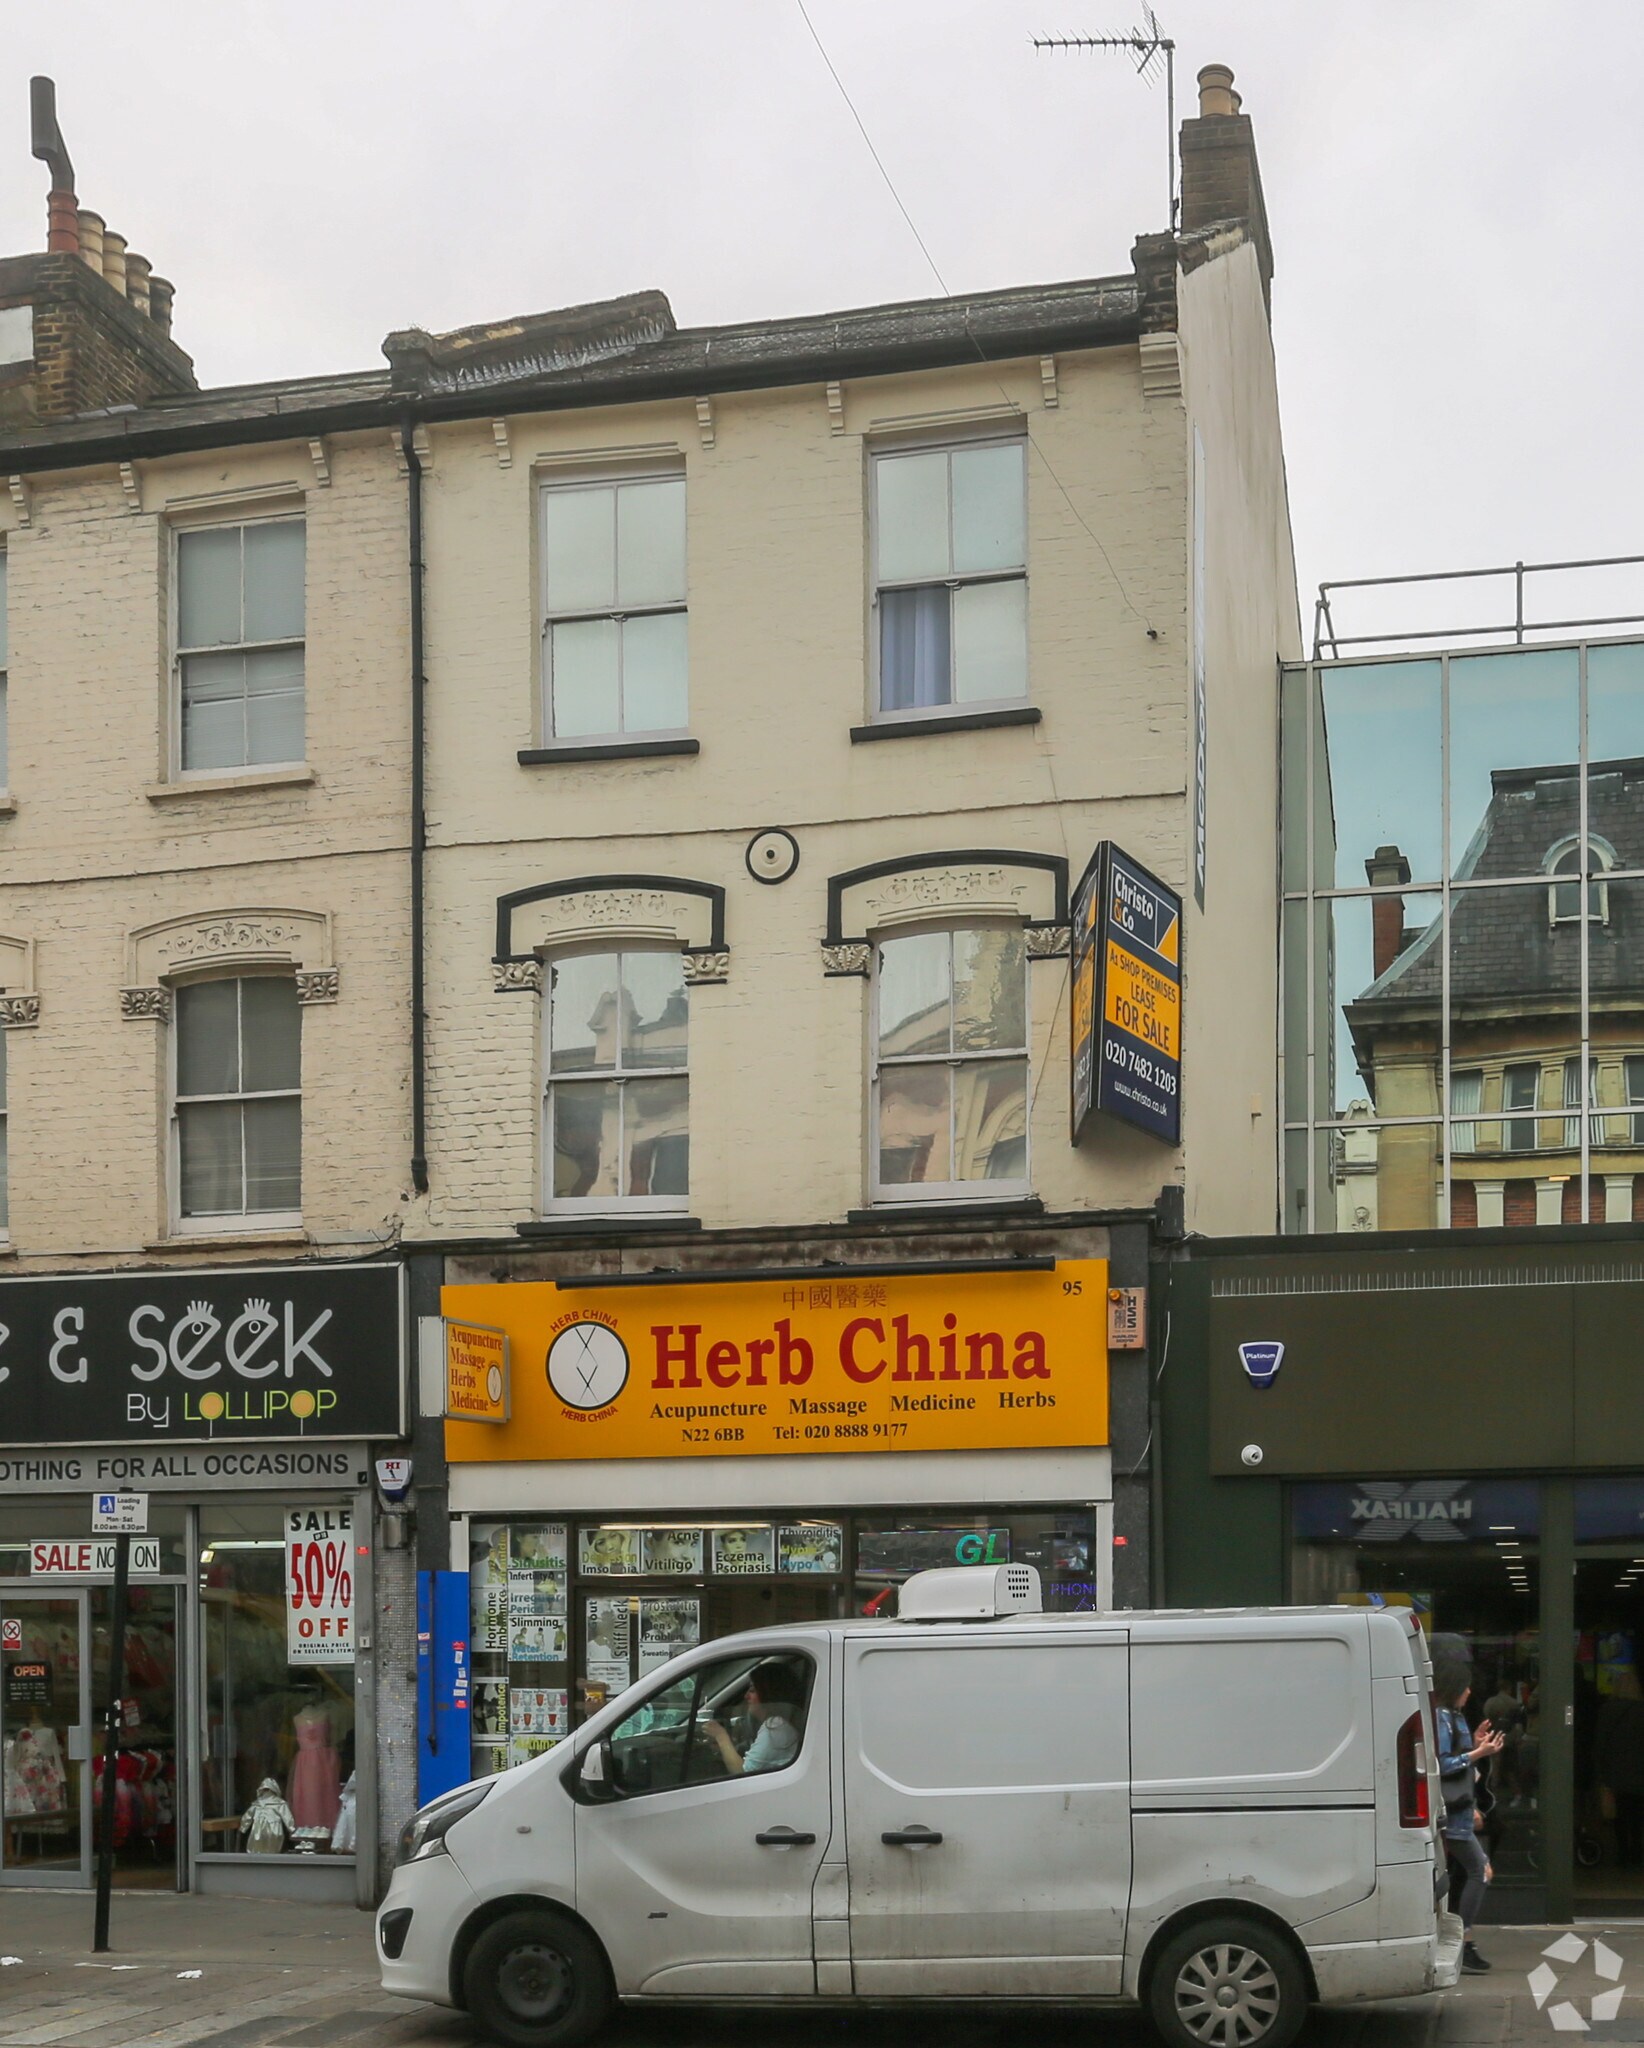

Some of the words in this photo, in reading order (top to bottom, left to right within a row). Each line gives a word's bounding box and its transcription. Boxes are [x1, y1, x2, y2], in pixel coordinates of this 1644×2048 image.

[1115, 873, 1154, 920] Christo
[1114, 898, 1121, 921] &
[1122, 907, 1134, 931] Co
[1120, 955, 1140, 978] SHOP
[1142, 969, 1176, 1003] PREMISES
[1131, 981, 1155, 1013] LEASE
[1116, 995, 1139, 1033] FOR
[1143, 1013, 1169, 1051] SALE
[1105, 1039, 1126, 1067] 020
[1129, 1051, 1152, 1082] 7482
[1155, 1066, 1176, 1095] 1203
[783, 1284, 888, 1311] 中國醫藥
[1062, 1281, 1082, 1296] 95
[550, 1311, 579, 1333] HERB
[582, 1309, 619, 1328] CHINA
[49, 1306, 88, 1383] &
[129, 1298, 333, 1381] Seek
[451, 1327, 503, 1351] Acupuncture
[651, 1318, 814, 1389] Herb
[839, 1312, 1051, 1384] China
[451, 1347, 486, 1372] Massage
[451, 1369, 476, 1388] Herbs
[127, 1393, 169, 1428] By
[184, 1390, 337, 1425] LOLLIPOP
[451, 1391, 488, 1411] Medicine
[650, 1402, 767, 1421] Acupuncture
[789, 1398, 867, 1416] Massage
[890, 1394, 976, 1411] Medicine
[999, 1391, 1056, 1408] Herbs
[561, 1408, 587, 1422] HERB
[588, 1406, 618, 1422] CHINA
[682, 1429, 710, 1441] N22
[715, 1428, 745, 1441] 6BB
[773, 1426, 800, 1439] Tel:
[805, 1425, 830, 1438] 020
[834, 1424, 868, 1437] 8888
[873, 1423, 907, 1437] 9177
[97, 1458, 145, 1479] FOR
[151, 1456, 196, 1477] ALL
[203, 1454, 349, 1476] OCCASIONS
[290, 1510, 351, 1531] SALE
[667, 1531, 700, 1541] Acne
[34, 1545, 92, 1571] SALE
[97, 1546, 116, 1568] NO
[135, 1546, 157, 1568] ON
[645, 1559, 692, 1572] Vitiligo
[716, 1552, 764, 1562] Eczema
[716, 1562, 771, 1574] Psoriasis
[291, 1540, 351, 1610] 50%
[299, 1617, 349, 1638] OFF
[485, 1591, 496, 1649] Hormone
[511, 1617, 559, 1629] Slimming
[613, 1600, 628, 1630] Neck
[613, 1631, 628, 1657] Stiff
[641, 1650, 673, 1658] Sweating
[14, 1665, 45, 1677] OPEN
[496, 1683, 508, 1734] Impotence
